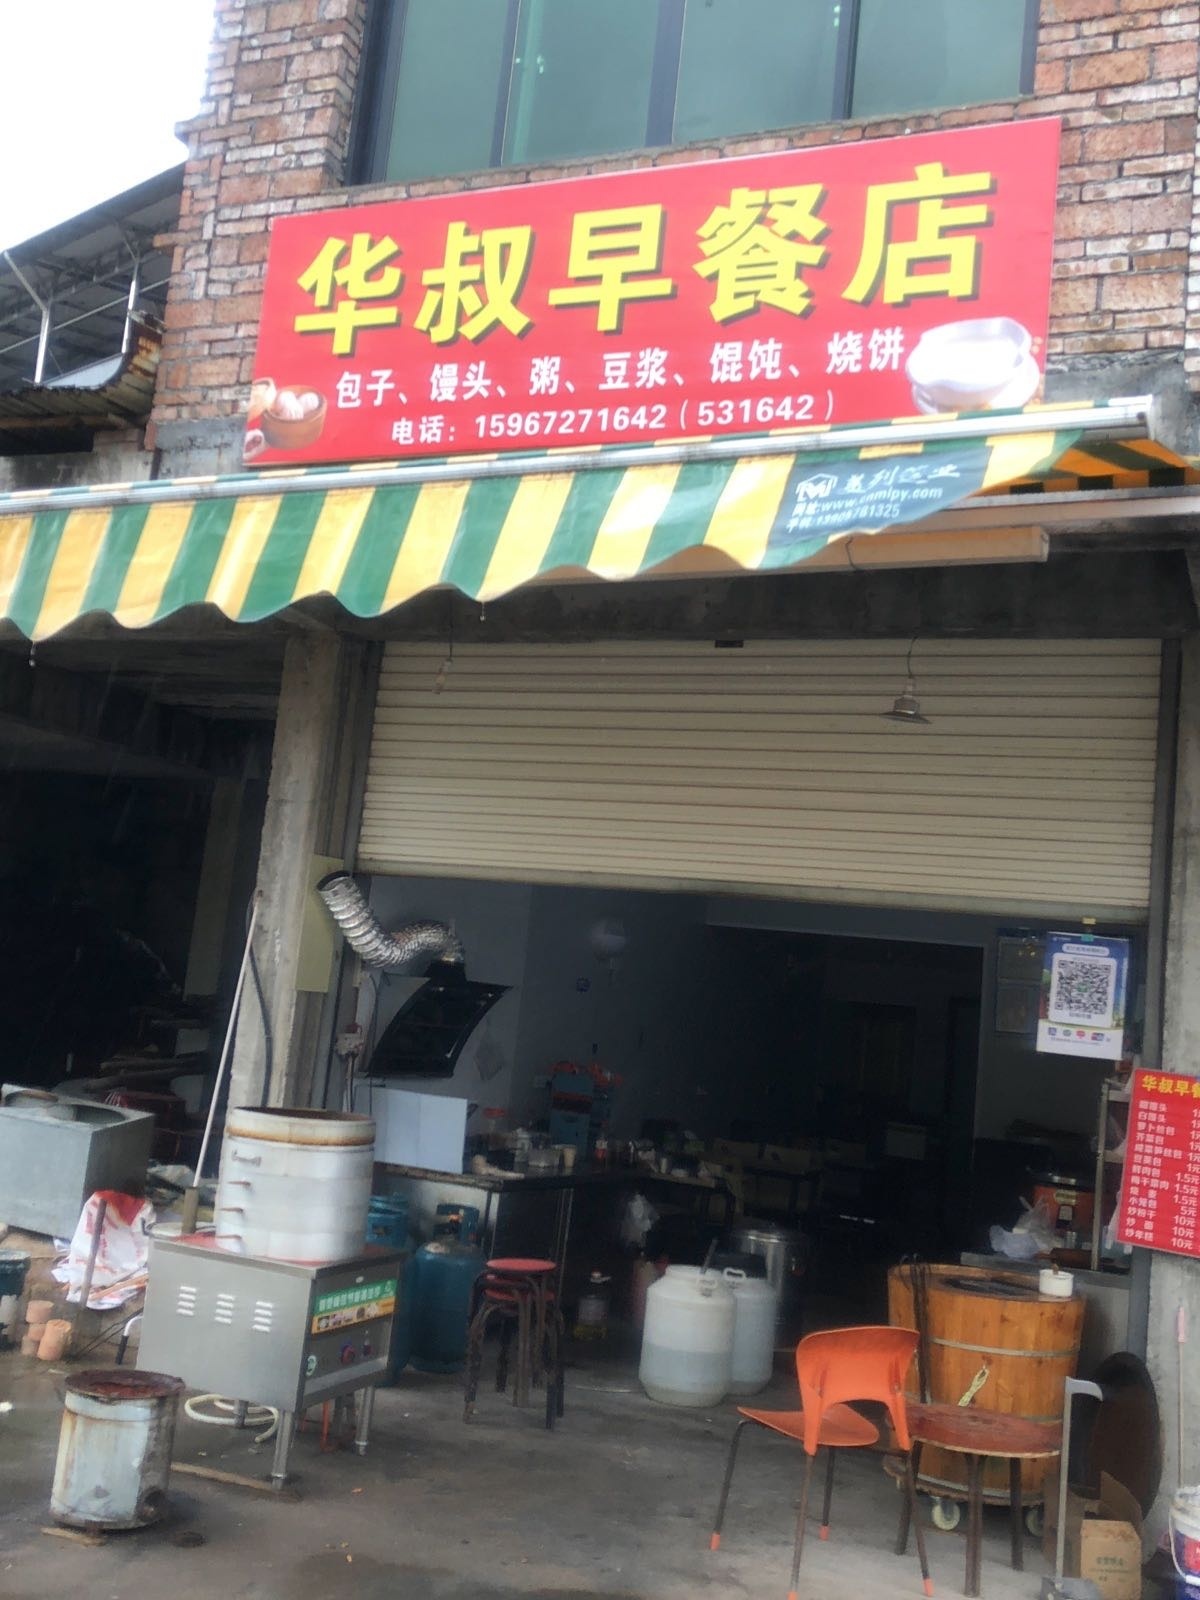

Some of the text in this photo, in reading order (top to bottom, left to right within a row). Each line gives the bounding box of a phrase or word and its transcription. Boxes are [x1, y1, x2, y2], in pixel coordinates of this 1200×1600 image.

[294, 162, 993, 354] 华叔早餐店
[1187, 1163, 1200, 1174] 1元
[1176, 1172, 1200, 1185] 1.5元
[1174, 1183, 1199, 1196] 1.5元
[1173, 1194, 1198, 1206] 1.5元
[1180, 1205, 1197, 1217] 5元
[1174, 1215, 1196, 1227] 10元
[1173, 1226, 1194, 1238] 10元
[1171, 1237, 1193, 1250] 10元
